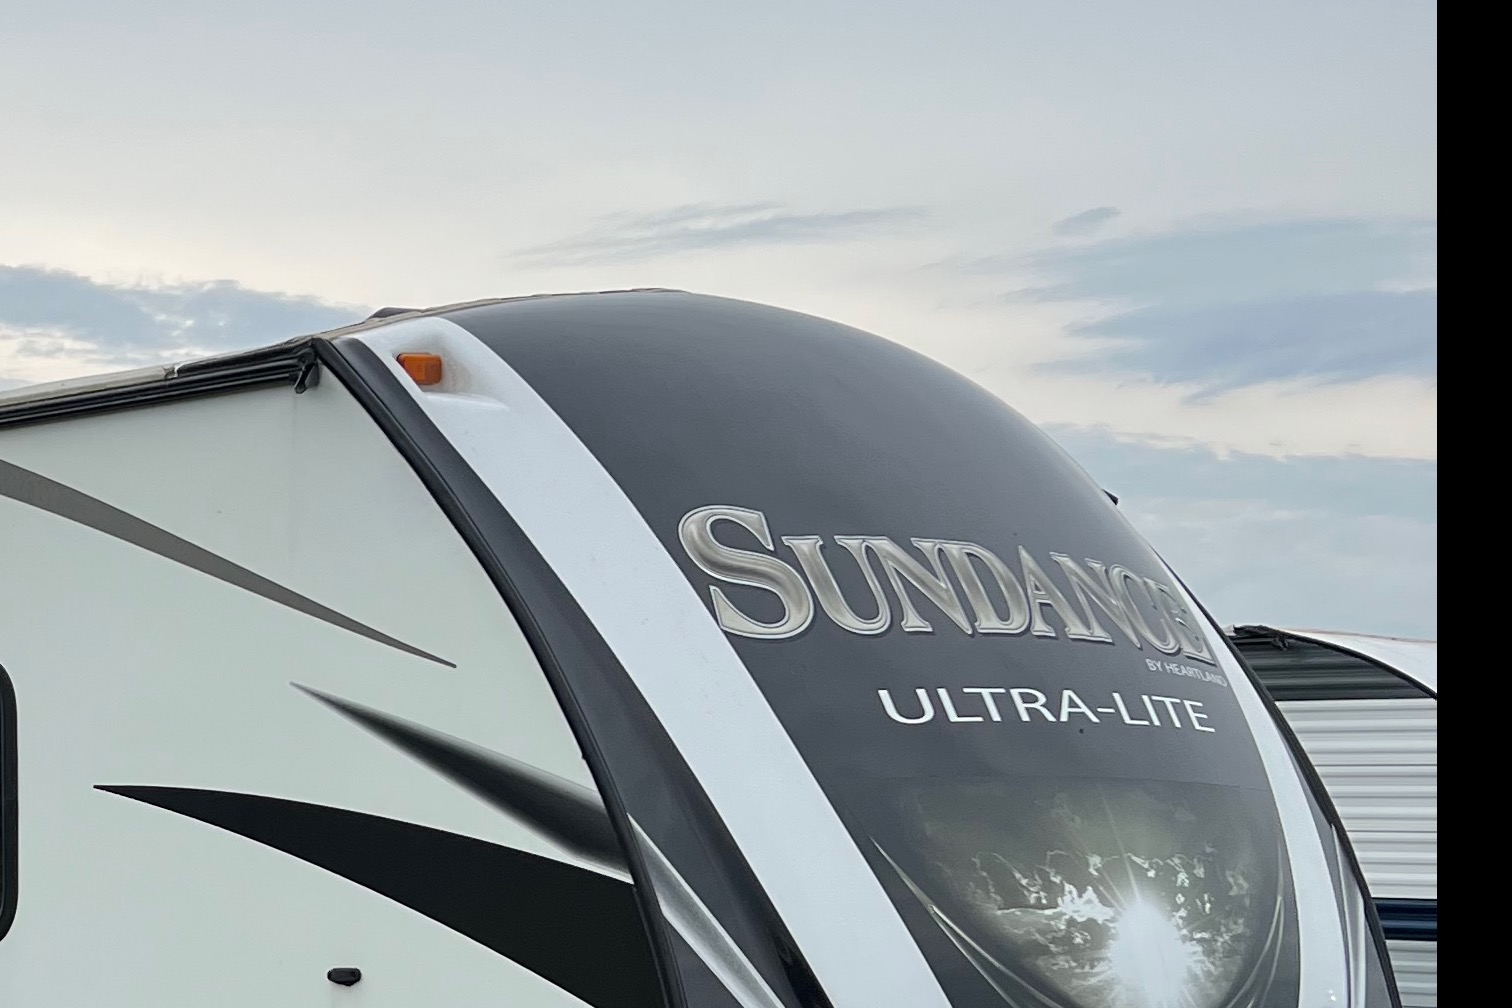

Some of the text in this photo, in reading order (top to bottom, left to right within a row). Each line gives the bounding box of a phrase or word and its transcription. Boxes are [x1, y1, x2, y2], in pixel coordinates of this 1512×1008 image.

[677, 503, 1217, 667] SUNDANCE
[1145, 658, 1228, 687] BY HEARTLAND
[877, 687, 1216, 733] ULTRA-LITE
